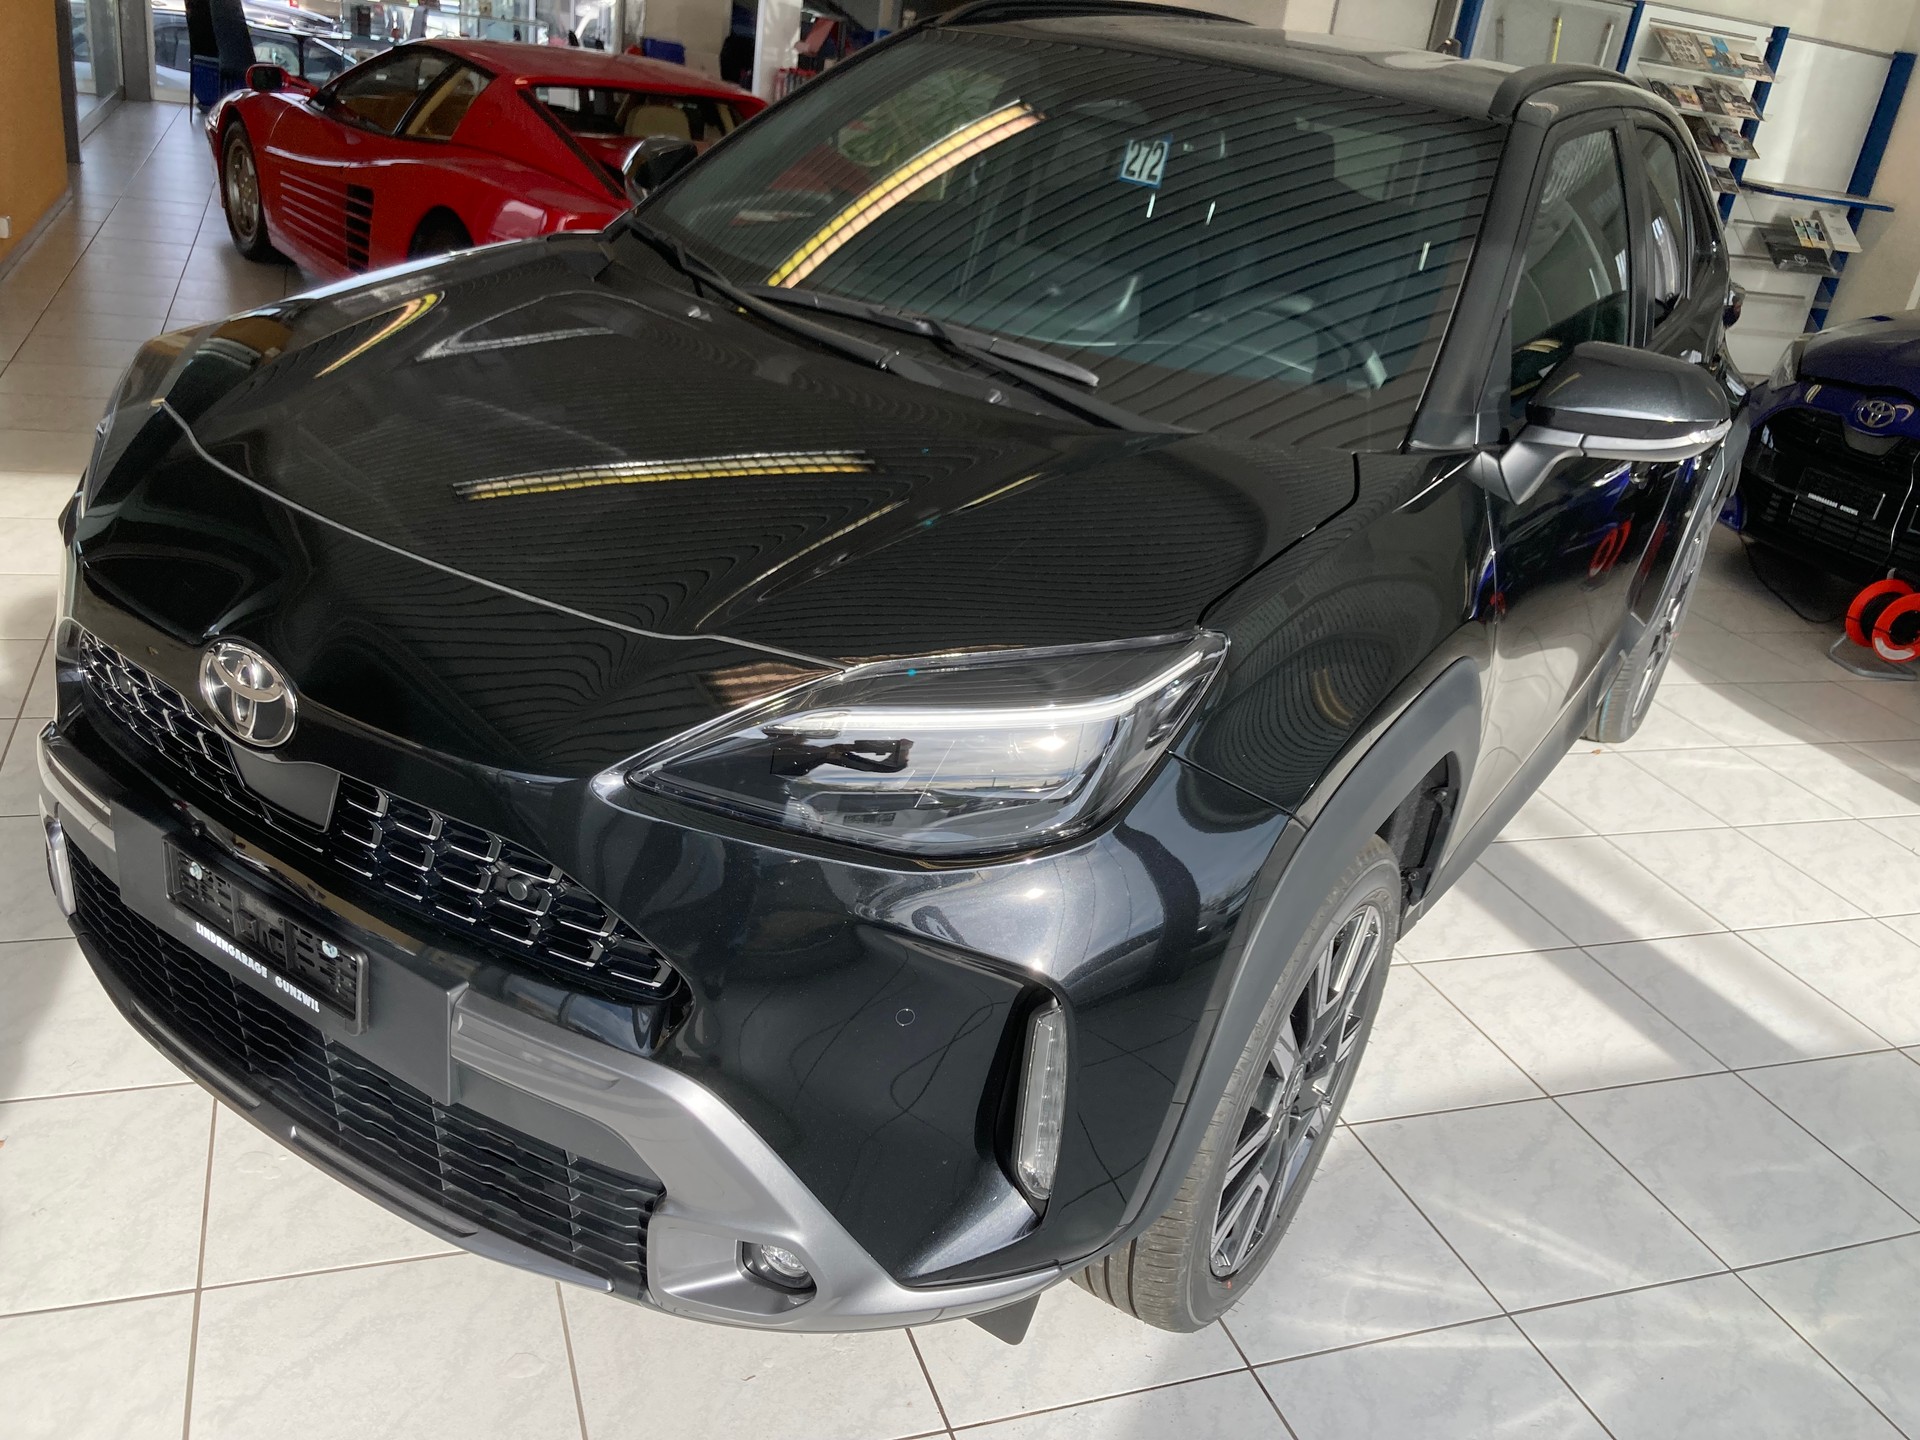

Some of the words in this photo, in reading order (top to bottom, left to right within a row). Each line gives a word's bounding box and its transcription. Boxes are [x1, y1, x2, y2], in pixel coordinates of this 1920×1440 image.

[1125, 141, 1165, 181] 272
[195, 921, 268, 979] LINDENGARAGE
[275, 976, 320, 1013] GUNZWIL
